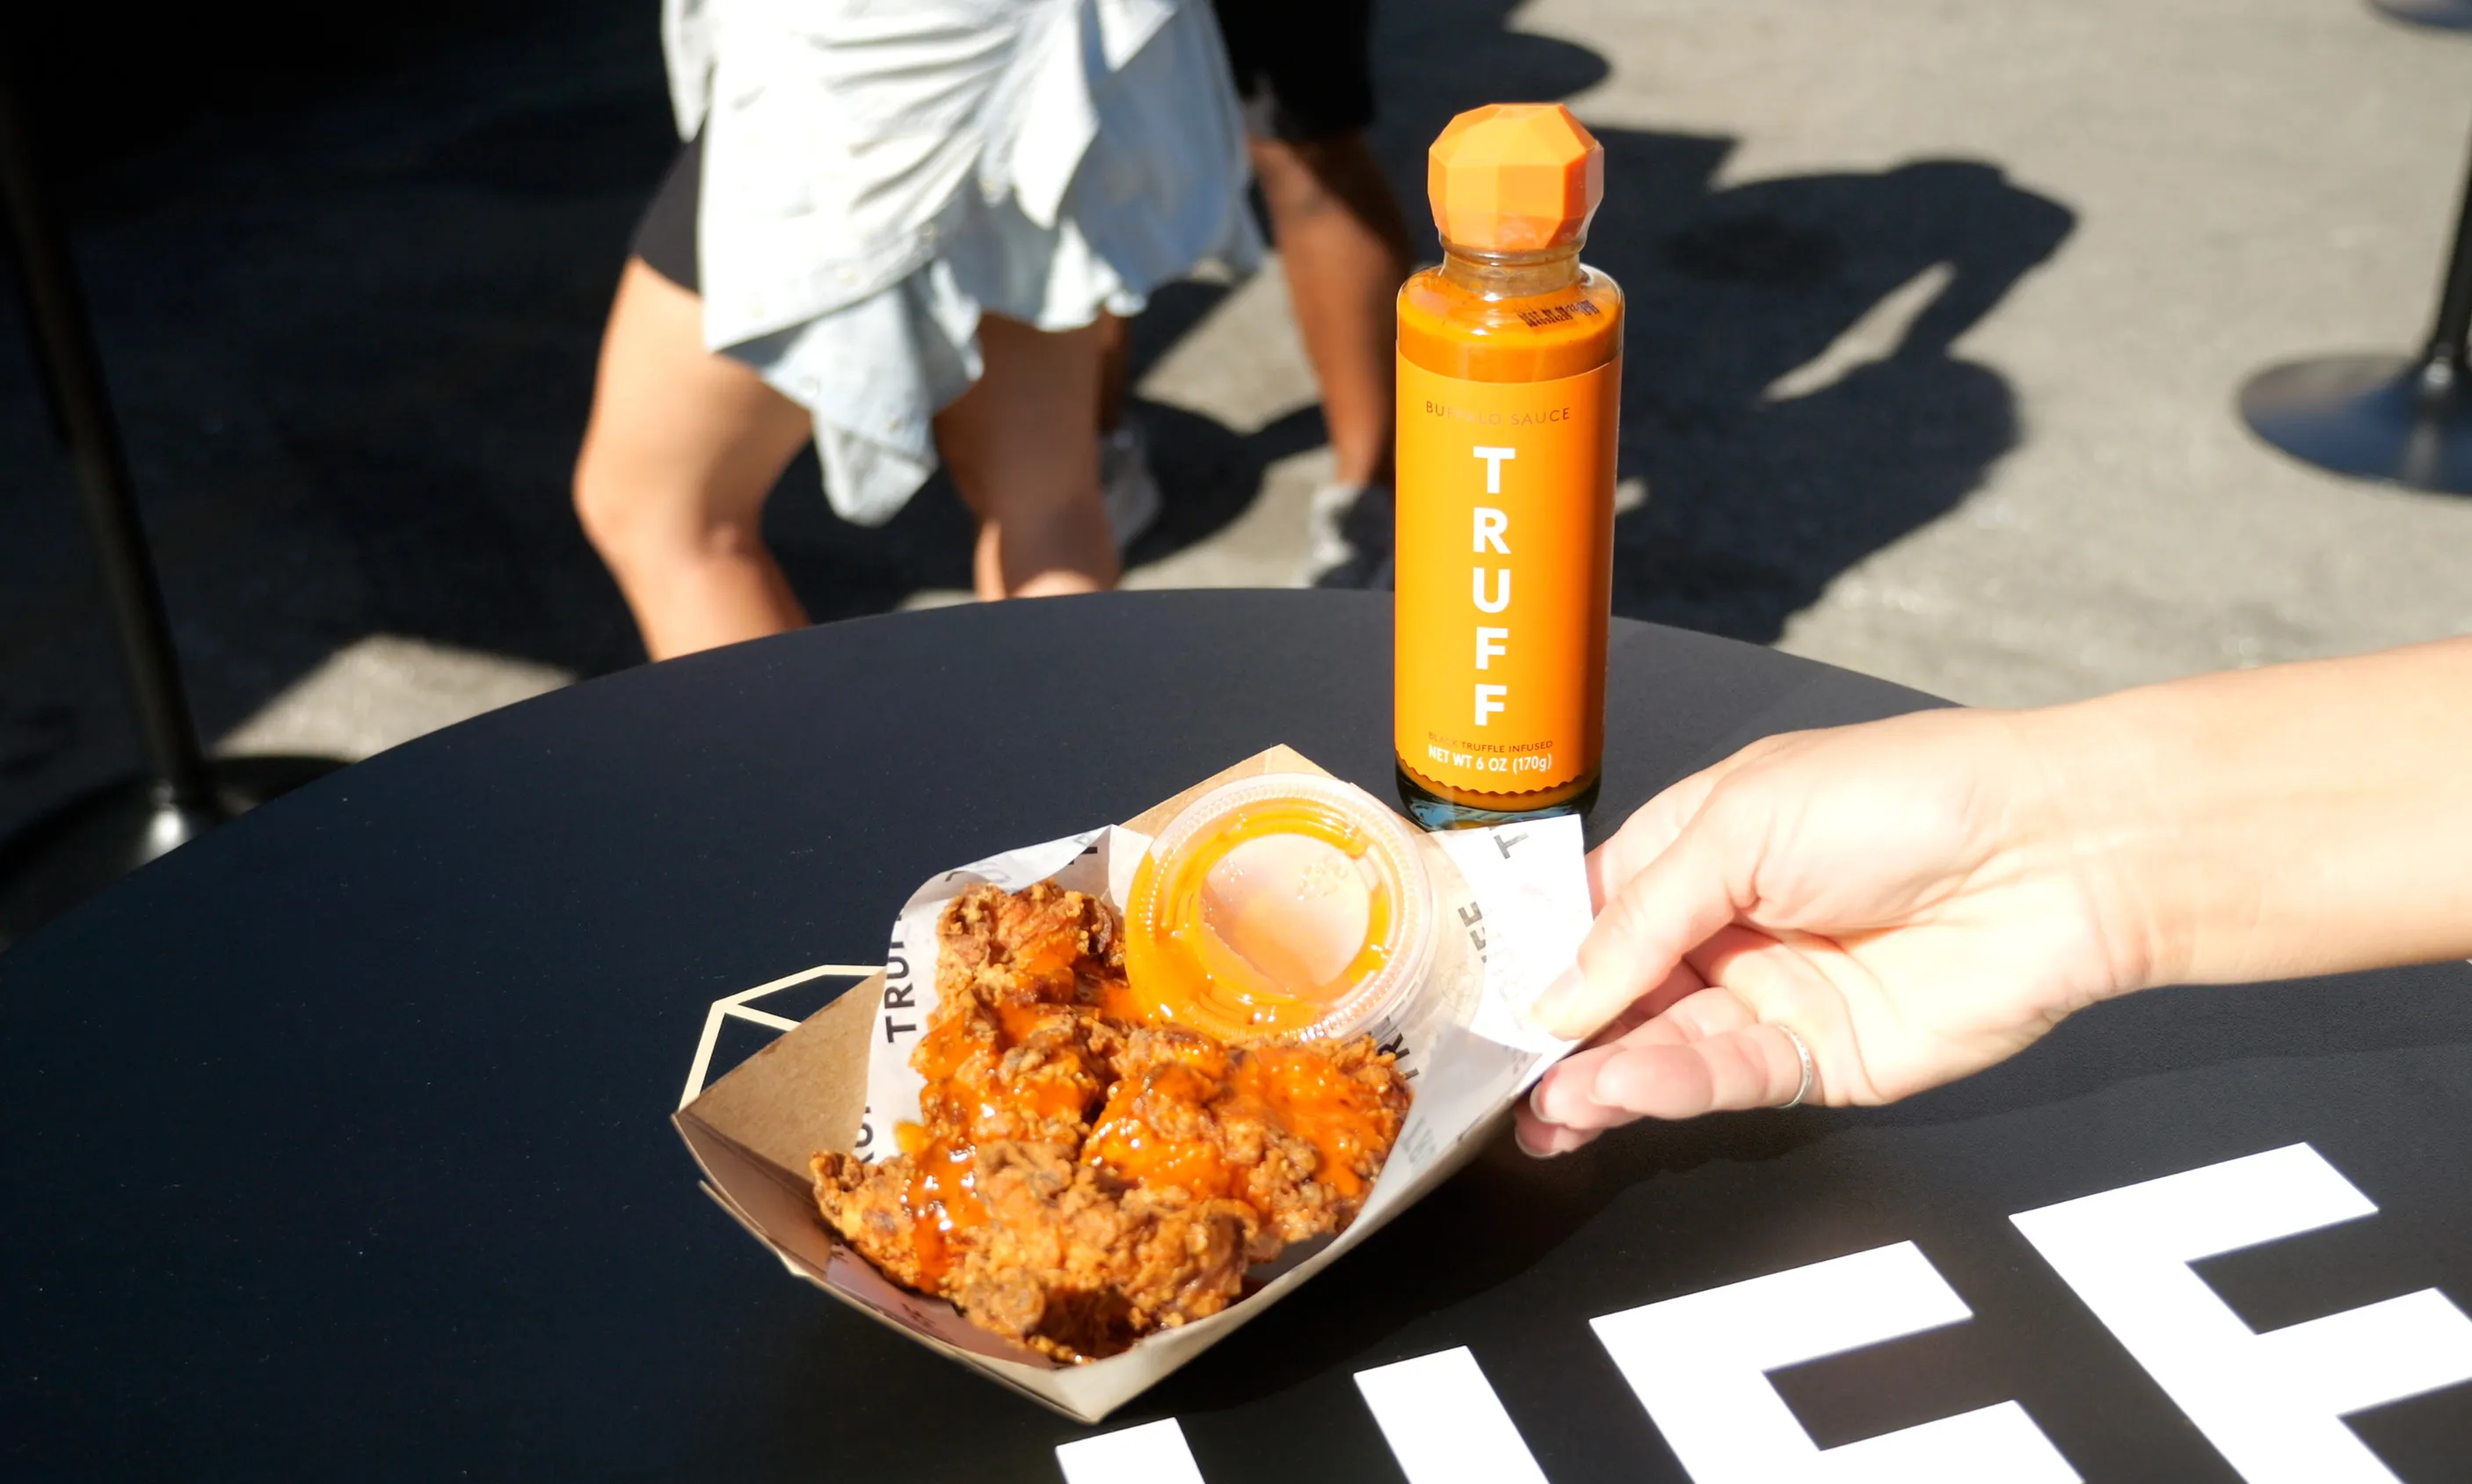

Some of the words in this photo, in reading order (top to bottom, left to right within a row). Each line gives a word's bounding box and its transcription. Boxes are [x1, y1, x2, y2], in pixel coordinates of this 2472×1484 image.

[1511, 407, 1570, 426] SAUCE
[1472, 446, 1516, 727] TRUFF
[1462, 741, 1505, 753] TRUFFLE
[1509, 740, 1553, 753] INFUSED
[1428, 744, 1450, 764] NET
[1452, 752, 1473, 769] WT
[1476, 756, 1485, 771] 6
[1488, 757, 1508, 772] OZ
[1512, 753, 1552, 775] (170g)
